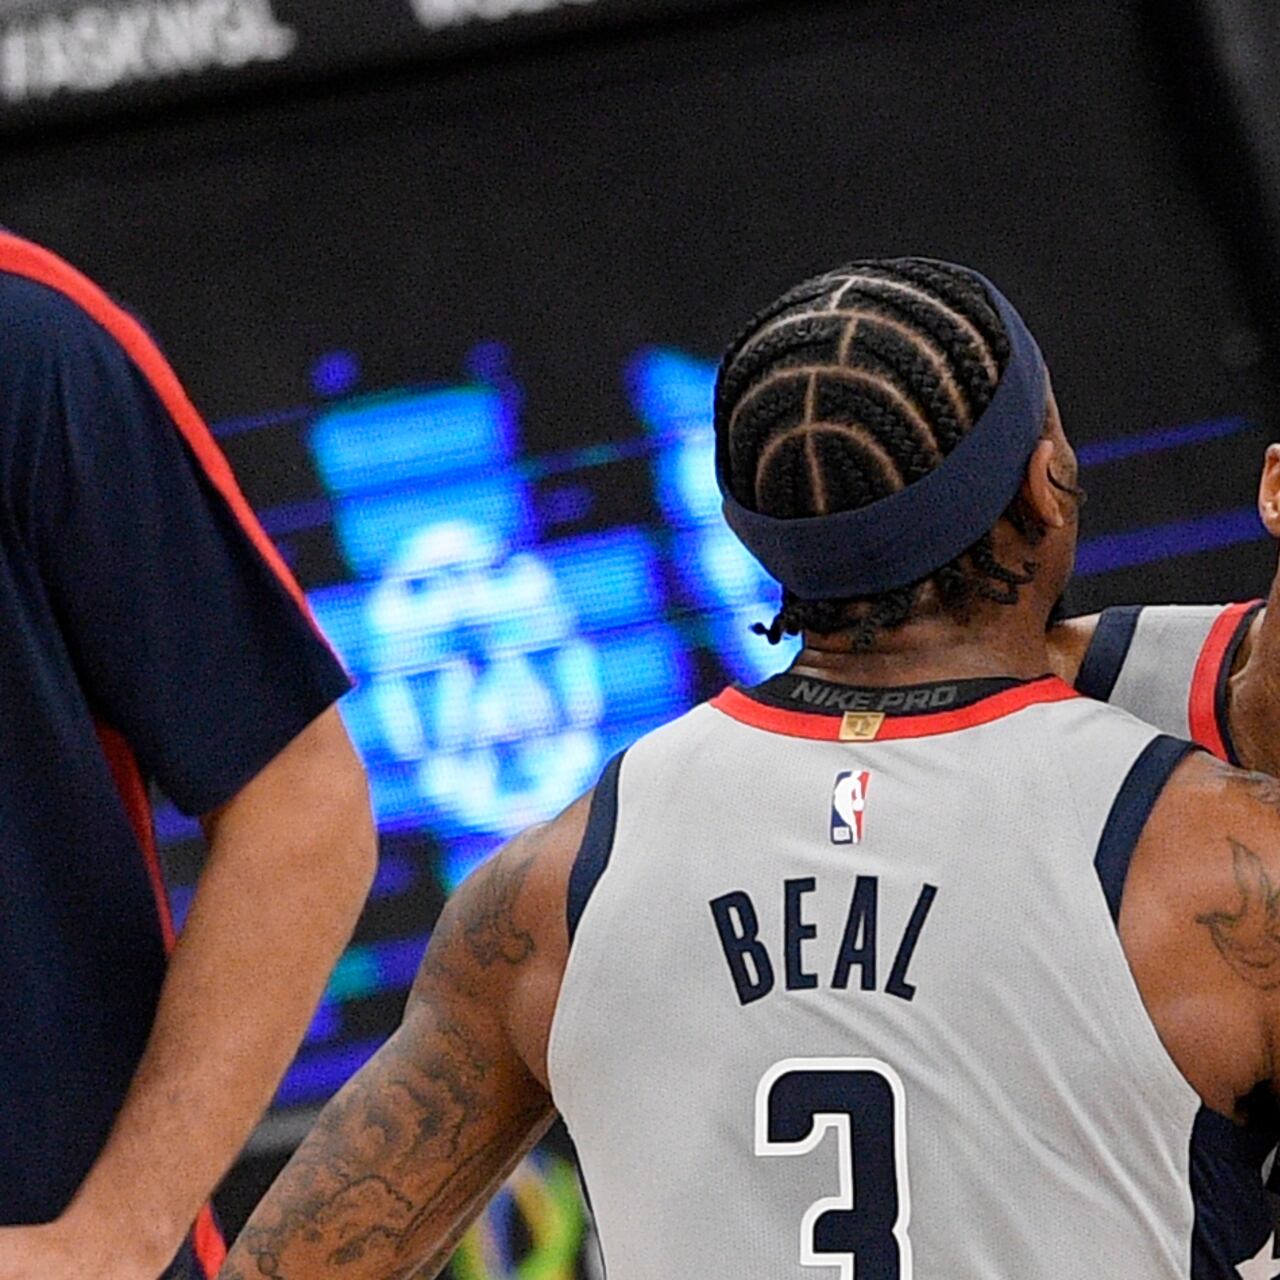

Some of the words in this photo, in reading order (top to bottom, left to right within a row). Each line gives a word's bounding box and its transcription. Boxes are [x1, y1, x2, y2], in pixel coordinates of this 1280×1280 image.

[791, 681, 874, 710] NIKE
[876, 686, 958, 711] PRO
[709, 875, 938, 1006] BEAL
